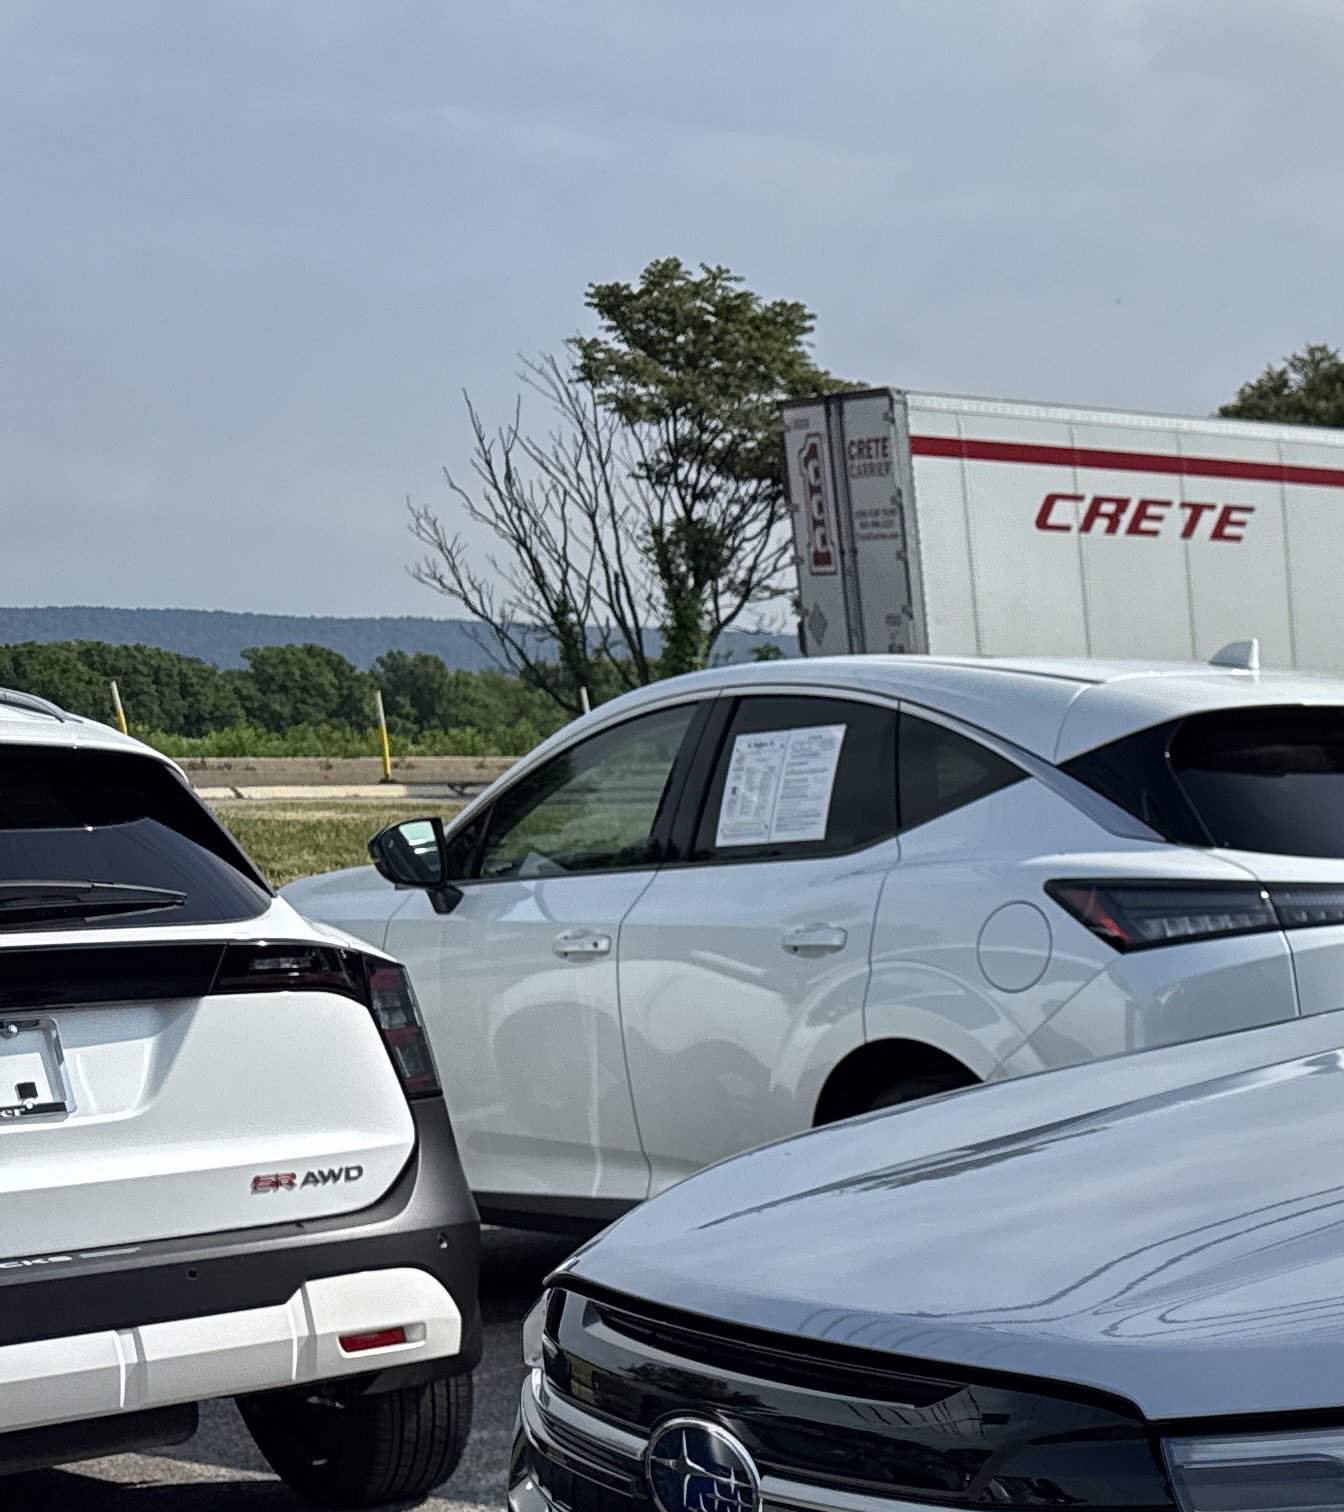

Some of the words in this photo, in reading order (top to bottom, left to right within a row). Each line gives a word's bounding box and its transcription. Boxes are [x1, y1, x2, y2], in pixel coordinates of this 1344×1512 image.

[849, 435, 890, 461] CRETE
[1035, 492, 1255, 544] CRETE
[300, 1165, 363, 1188] AWD
